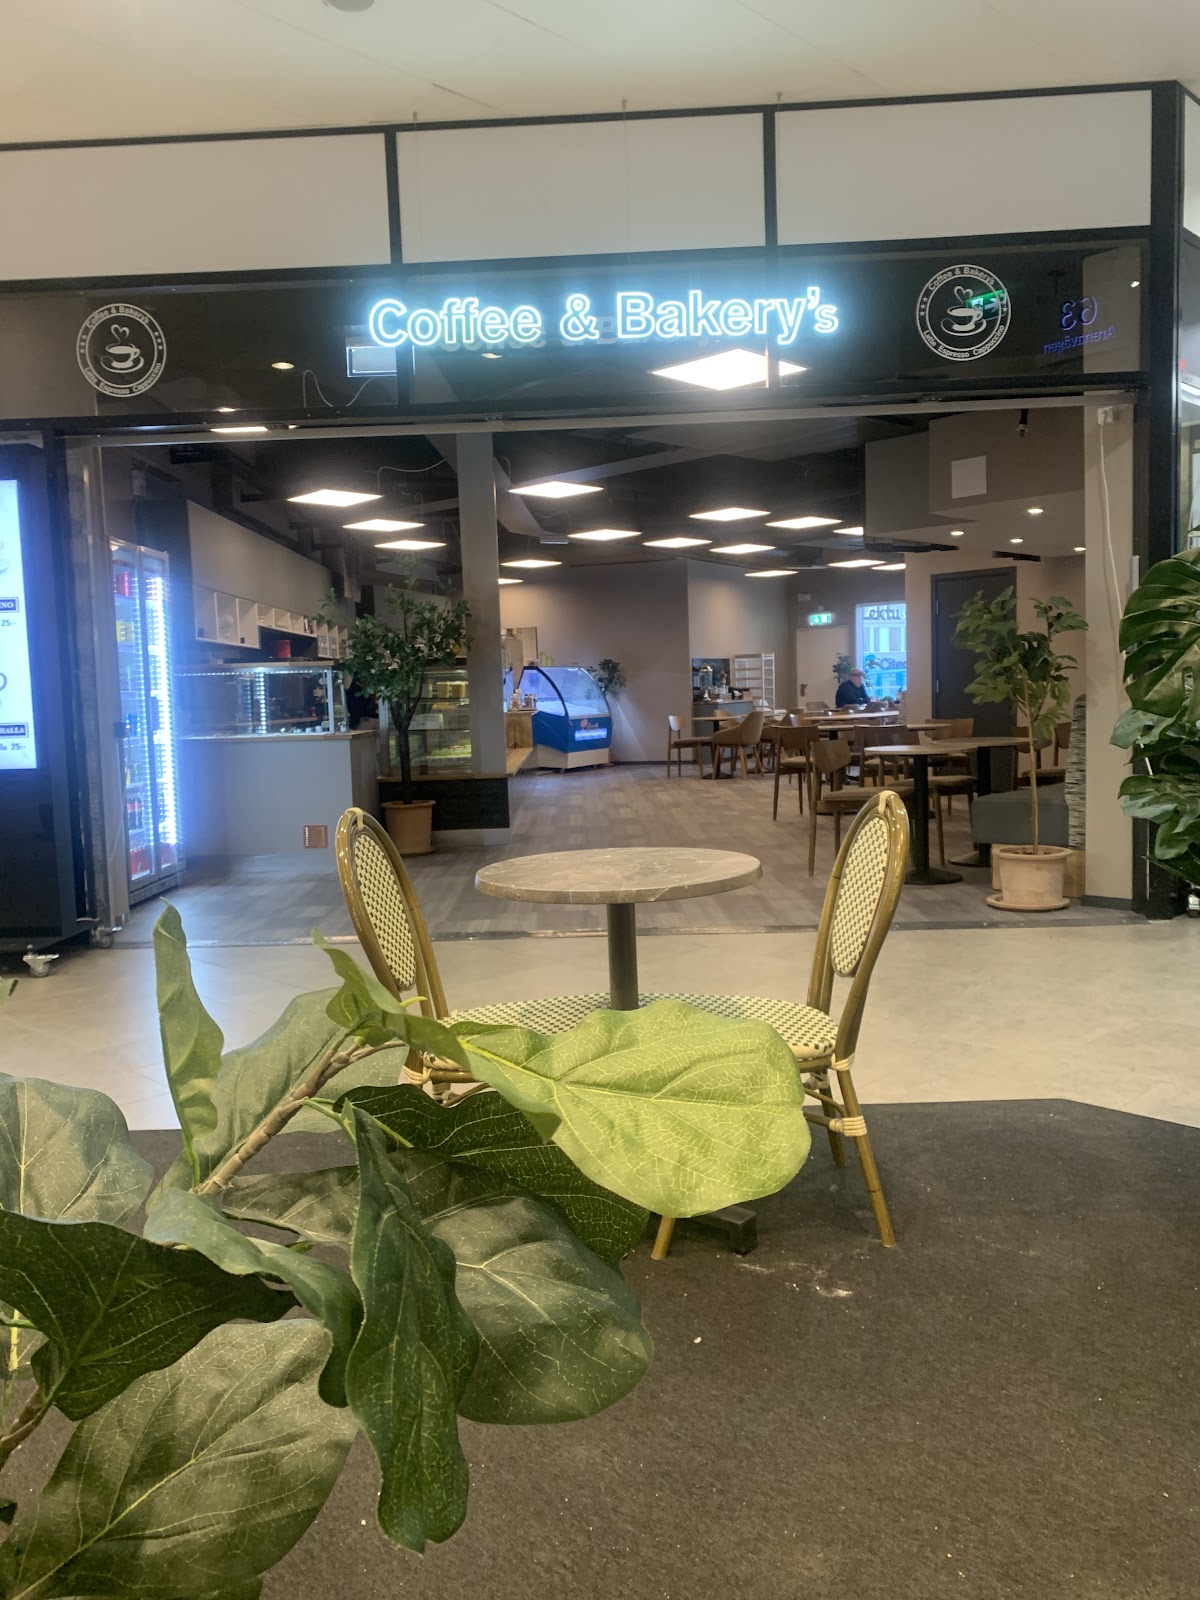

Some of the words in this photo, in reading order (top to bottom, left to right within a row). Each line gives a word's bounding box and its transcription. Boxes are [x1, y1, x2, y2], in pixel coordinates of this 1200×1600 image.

[929, 271, 953, 291] Coffee
[954, 267, 961, 275] &
[86, 309, 109, 329] Coffee
[110, 306, 117, 314] &
[368, 298, 543, 347] Coffee
[559, 293, 600, 341] &
[616, 286, 839, 345] Bakery's
[923, 330, 937, 347] Latte
[938, 345, 970, 358] Espresso
[973, 324, 1005, 356] Cappuccino
[98, 382, 130, 395] Espresso
[132, 362, 162, 392] Cappuccino
